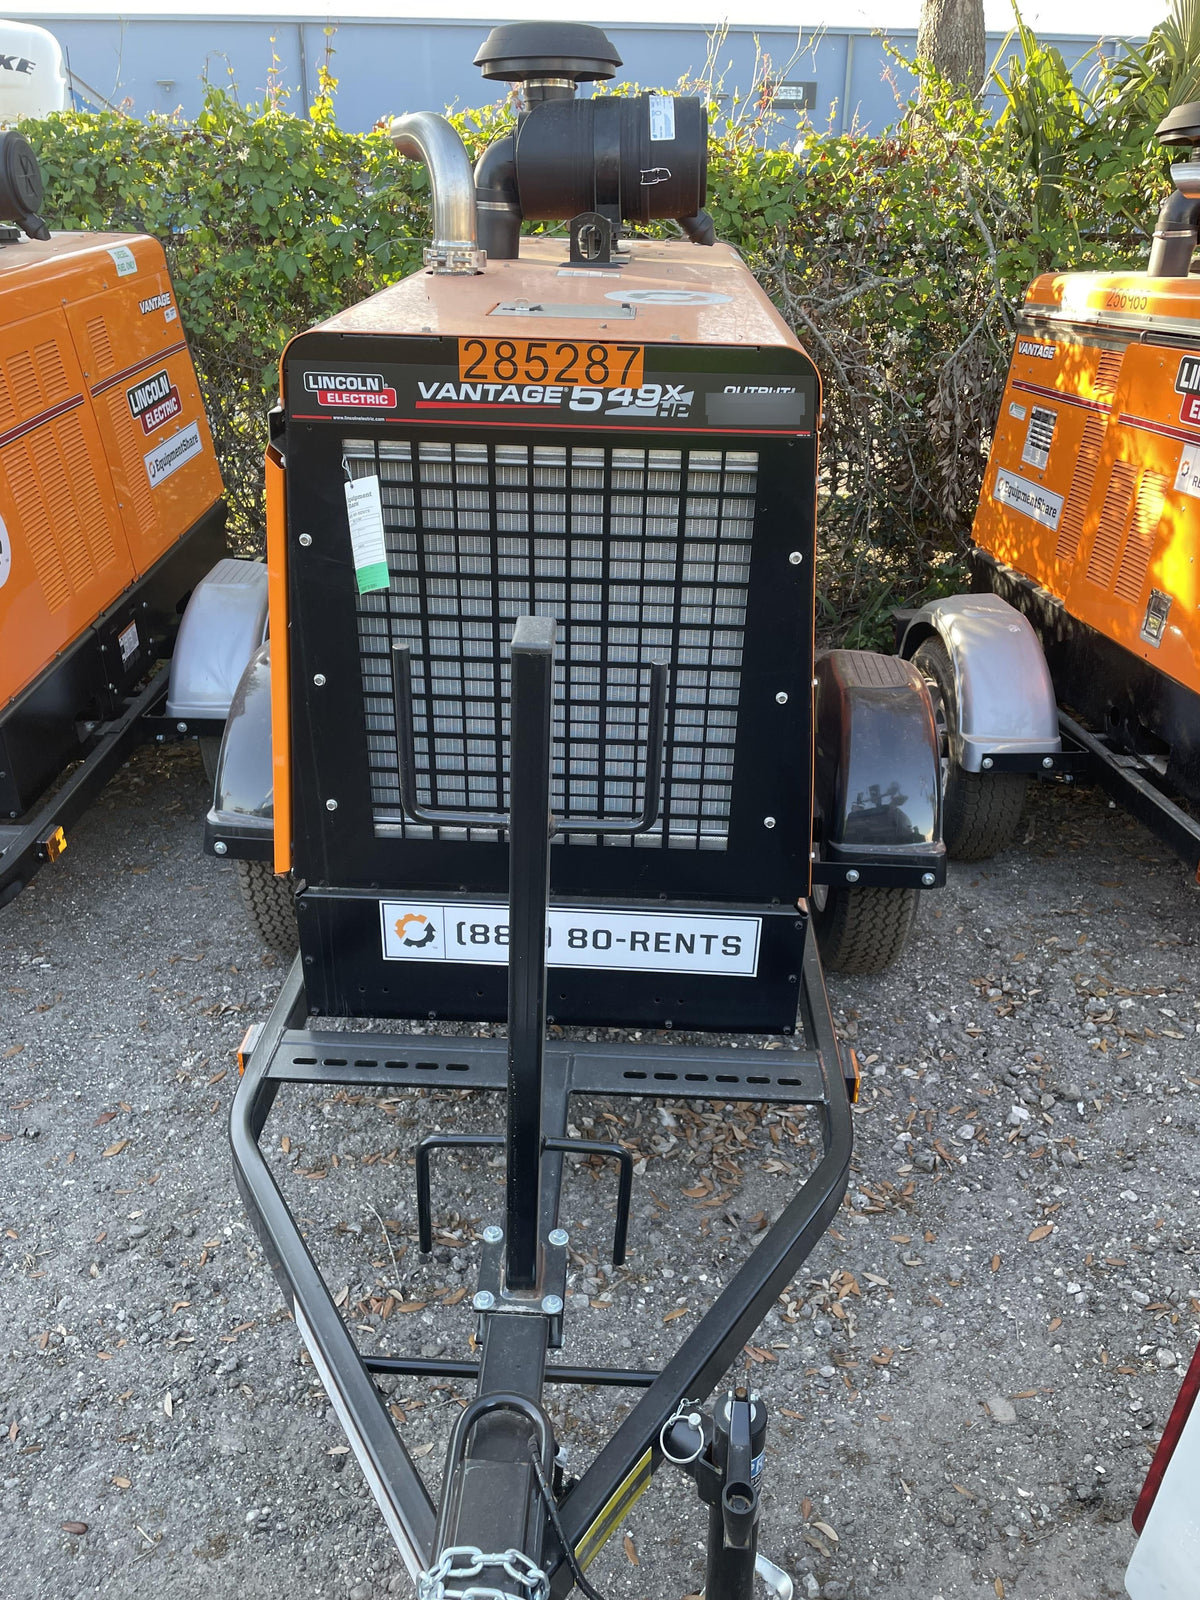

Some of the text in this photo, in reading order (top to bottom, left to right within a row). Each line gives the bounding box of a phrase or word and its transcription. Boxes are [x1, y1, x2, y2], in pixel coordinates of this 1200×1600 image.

[138, 292, 171, 315] VANTAGE
[463, 339, 641, 385] 285287
[1018, 341, 1056, 360] VANTAGE
[129, 374, 171, 414] LINCOLN
[308, 375, 380, 391] LINCOLN
[326, 392, 389, 405] ELECTRIC
[417, 381, 564, 404] VANTAGE
[145, 396, 179, 429] ELECTRIC
[154, 433, 199, 472] EquipmentShare
[1004, 481, 1057, 519] EquipmentShare
[456, 919, 742, 956] (88) 80-RENTS
